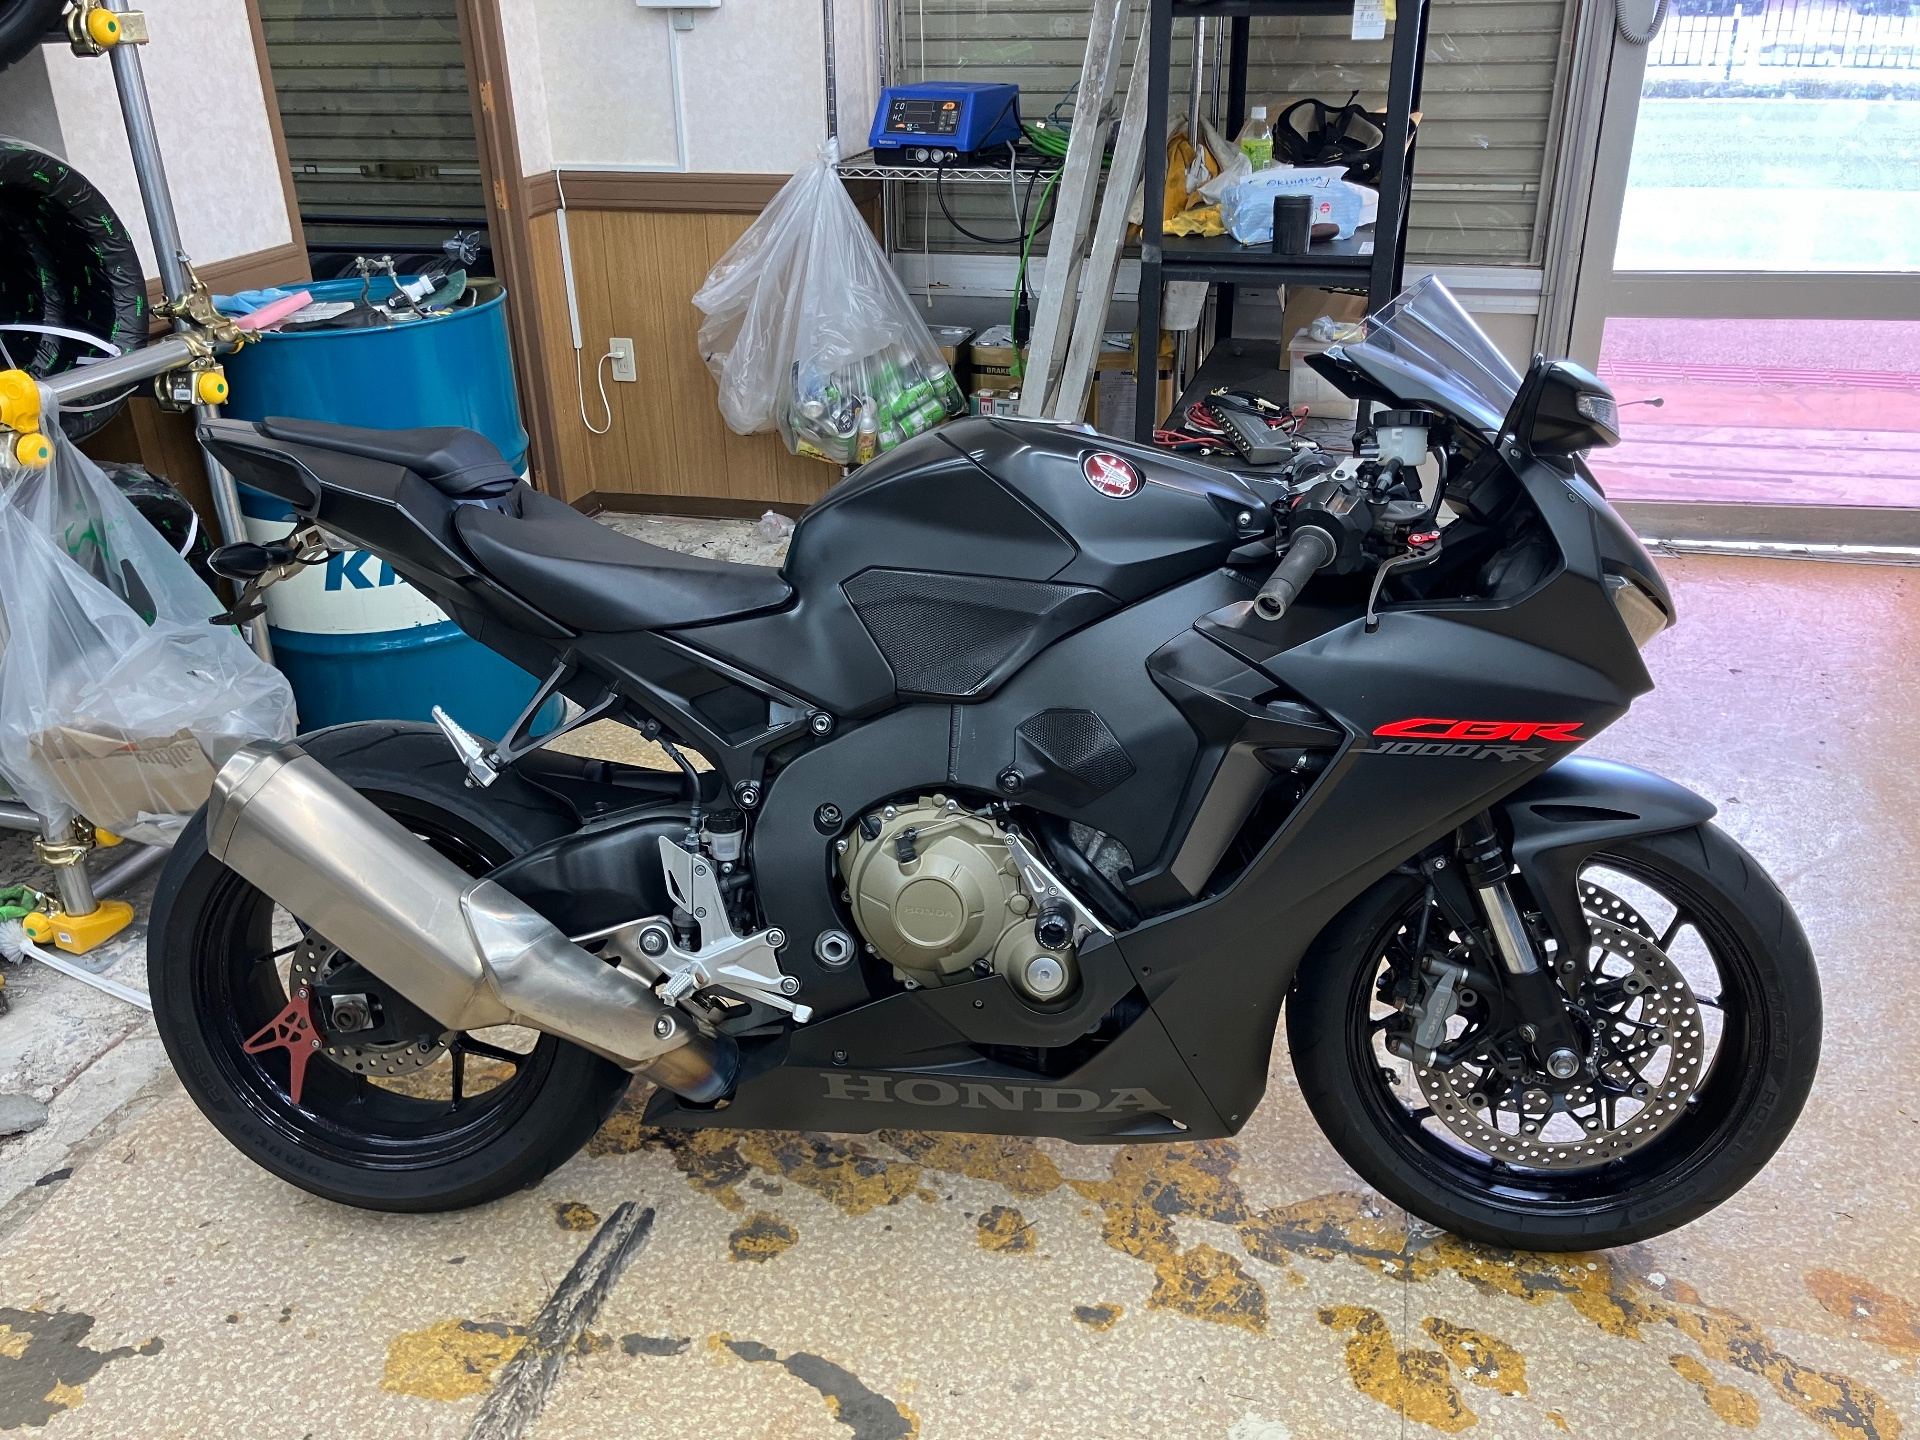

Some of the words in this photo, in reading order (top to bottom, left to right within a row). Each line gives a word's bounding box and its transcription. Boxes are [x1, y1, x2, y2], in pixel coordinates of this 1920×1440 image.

[894, 102, 906, 110] CO
[892, 113, 903, 121] HC
[986, 367, 1010, 375] BRAKE
[1092, 475, 1131, 491] HONDA
[1372, 718, 1586, 742] CBR
[1366, 742, 1547, 762] 1000RR
[903, 905, 955, 918] HONDA
[1425, 998, 1446, 1041] TOKICO
[819, 1072, 1172, 1114] HONDA
